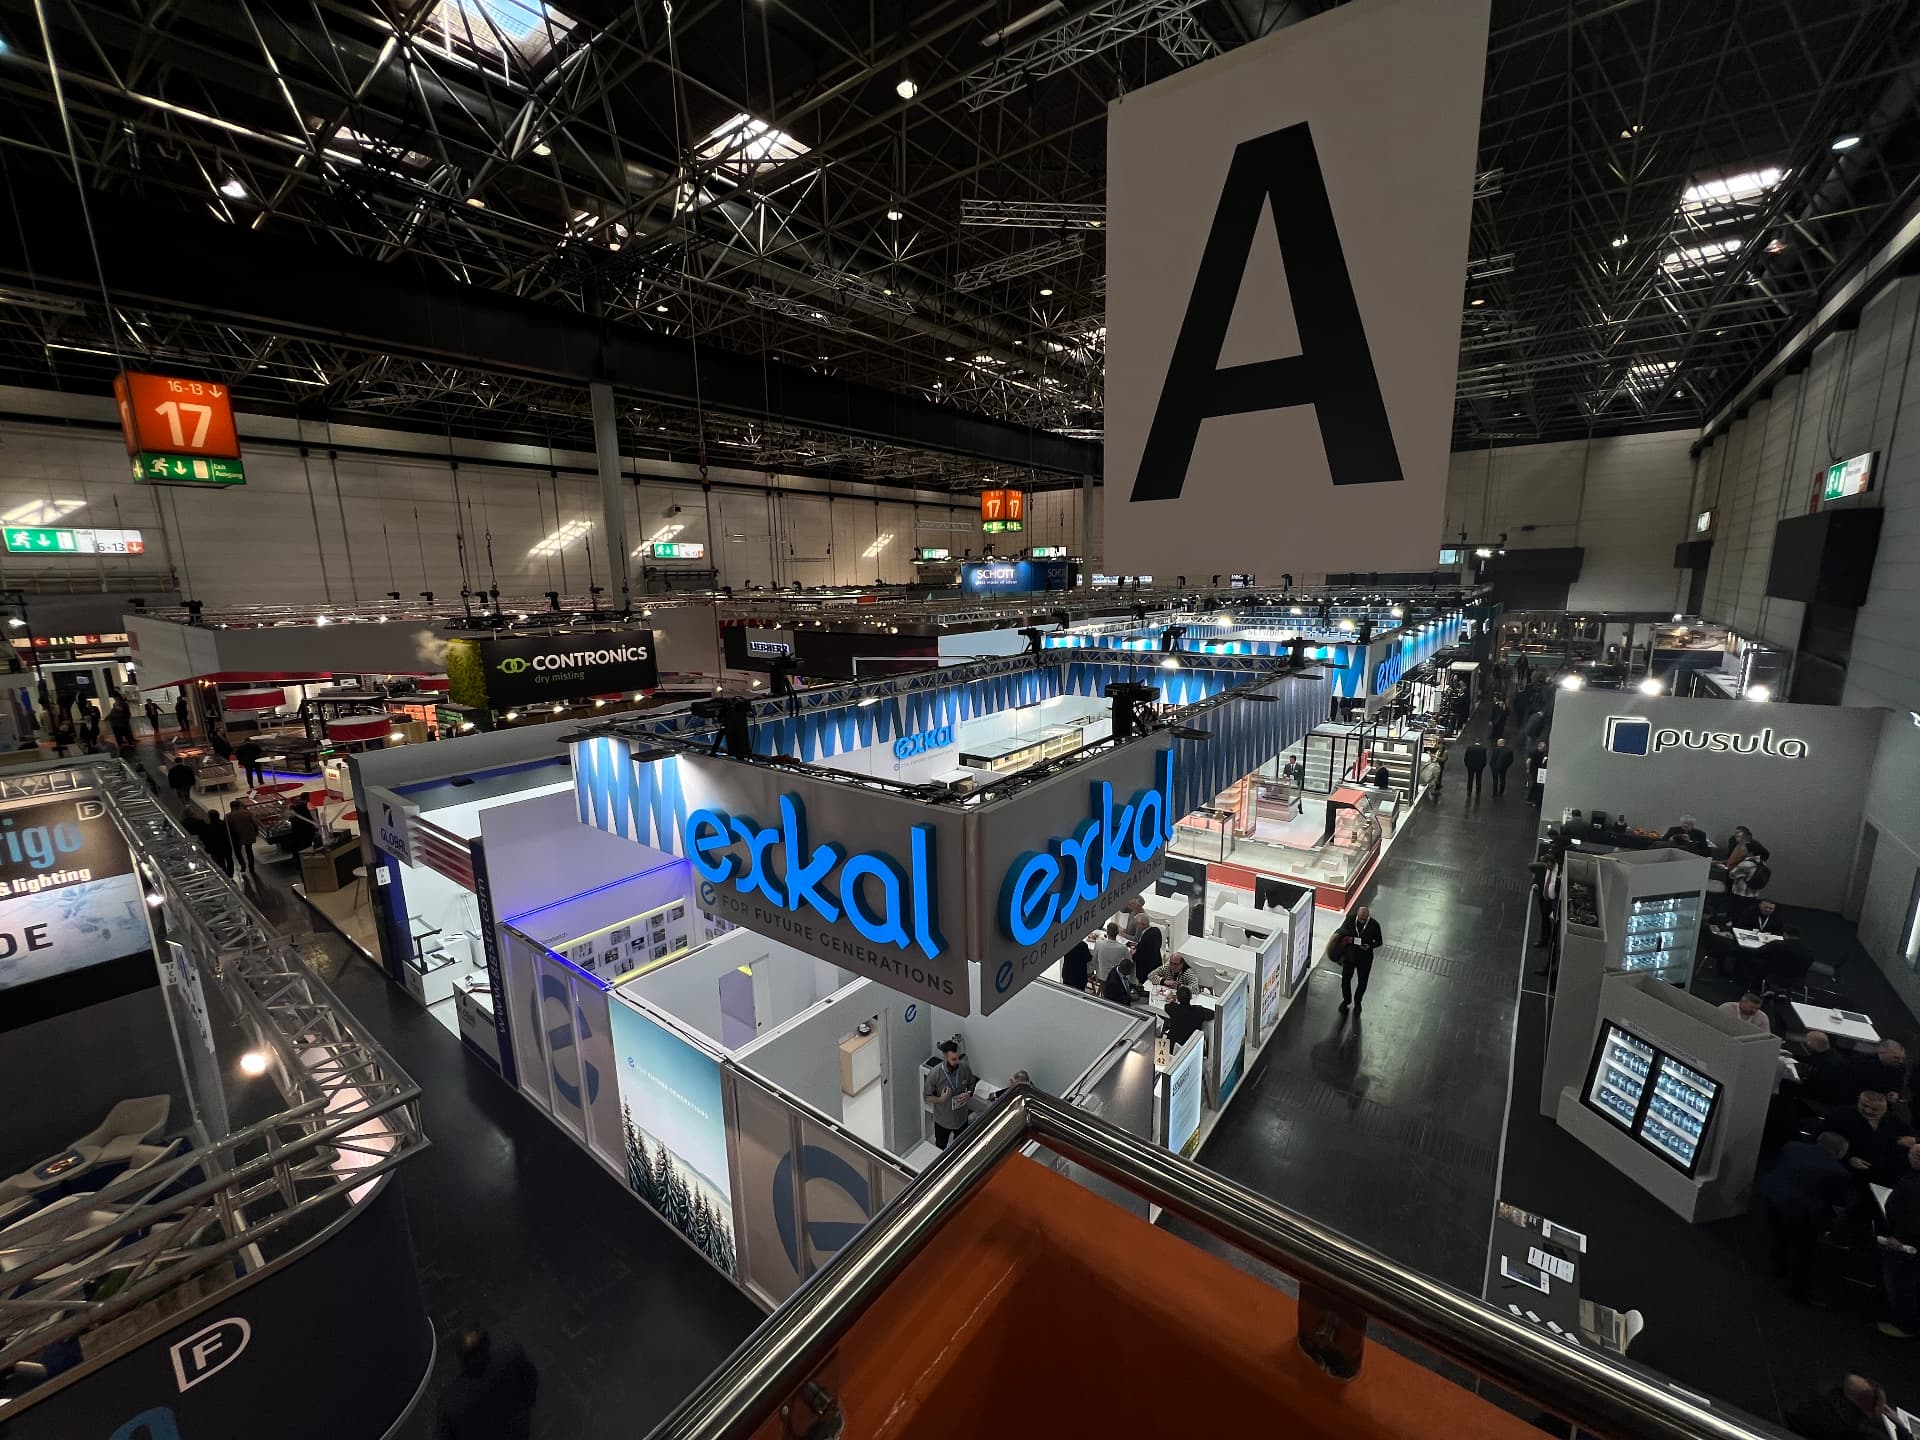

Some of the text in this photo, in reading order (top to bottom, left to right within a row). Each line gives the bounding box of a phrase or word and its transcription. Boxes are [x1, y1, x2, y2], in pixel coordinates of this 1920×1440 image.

[1129, 121, 1404, 502] A
[167, 380, 203, 396] 16-13
[155, 401, 212, 448] 17
[986, 499, 1001, 518] 17
[1009, 499, 1020, 518] 17
[92, 542, 126, 552] 6-13
[976, 569, 1015, 579] SCHOTT
[535, 671, 585, 684] dry misting
[893, 724, 956, 760] exkal
[1653, 728, 1809, 759] pusula
[0, 818, 83, 869] igo
[1003, 748, 1174, 947] exkal
[13, 868, 91, 893] lighting
[685, 793, 944, 960] exkal
[1021, 944, 1048, 973] FOR
[1053, 908, 1097, 948] FUTURE
[1100, 857, 1163, 911] GENERATIONS
[723, 894, 748, 914] FOR
[755, 905, 813, 941] FUTURE
[820, 931, 955, 996] GENERATIONS
